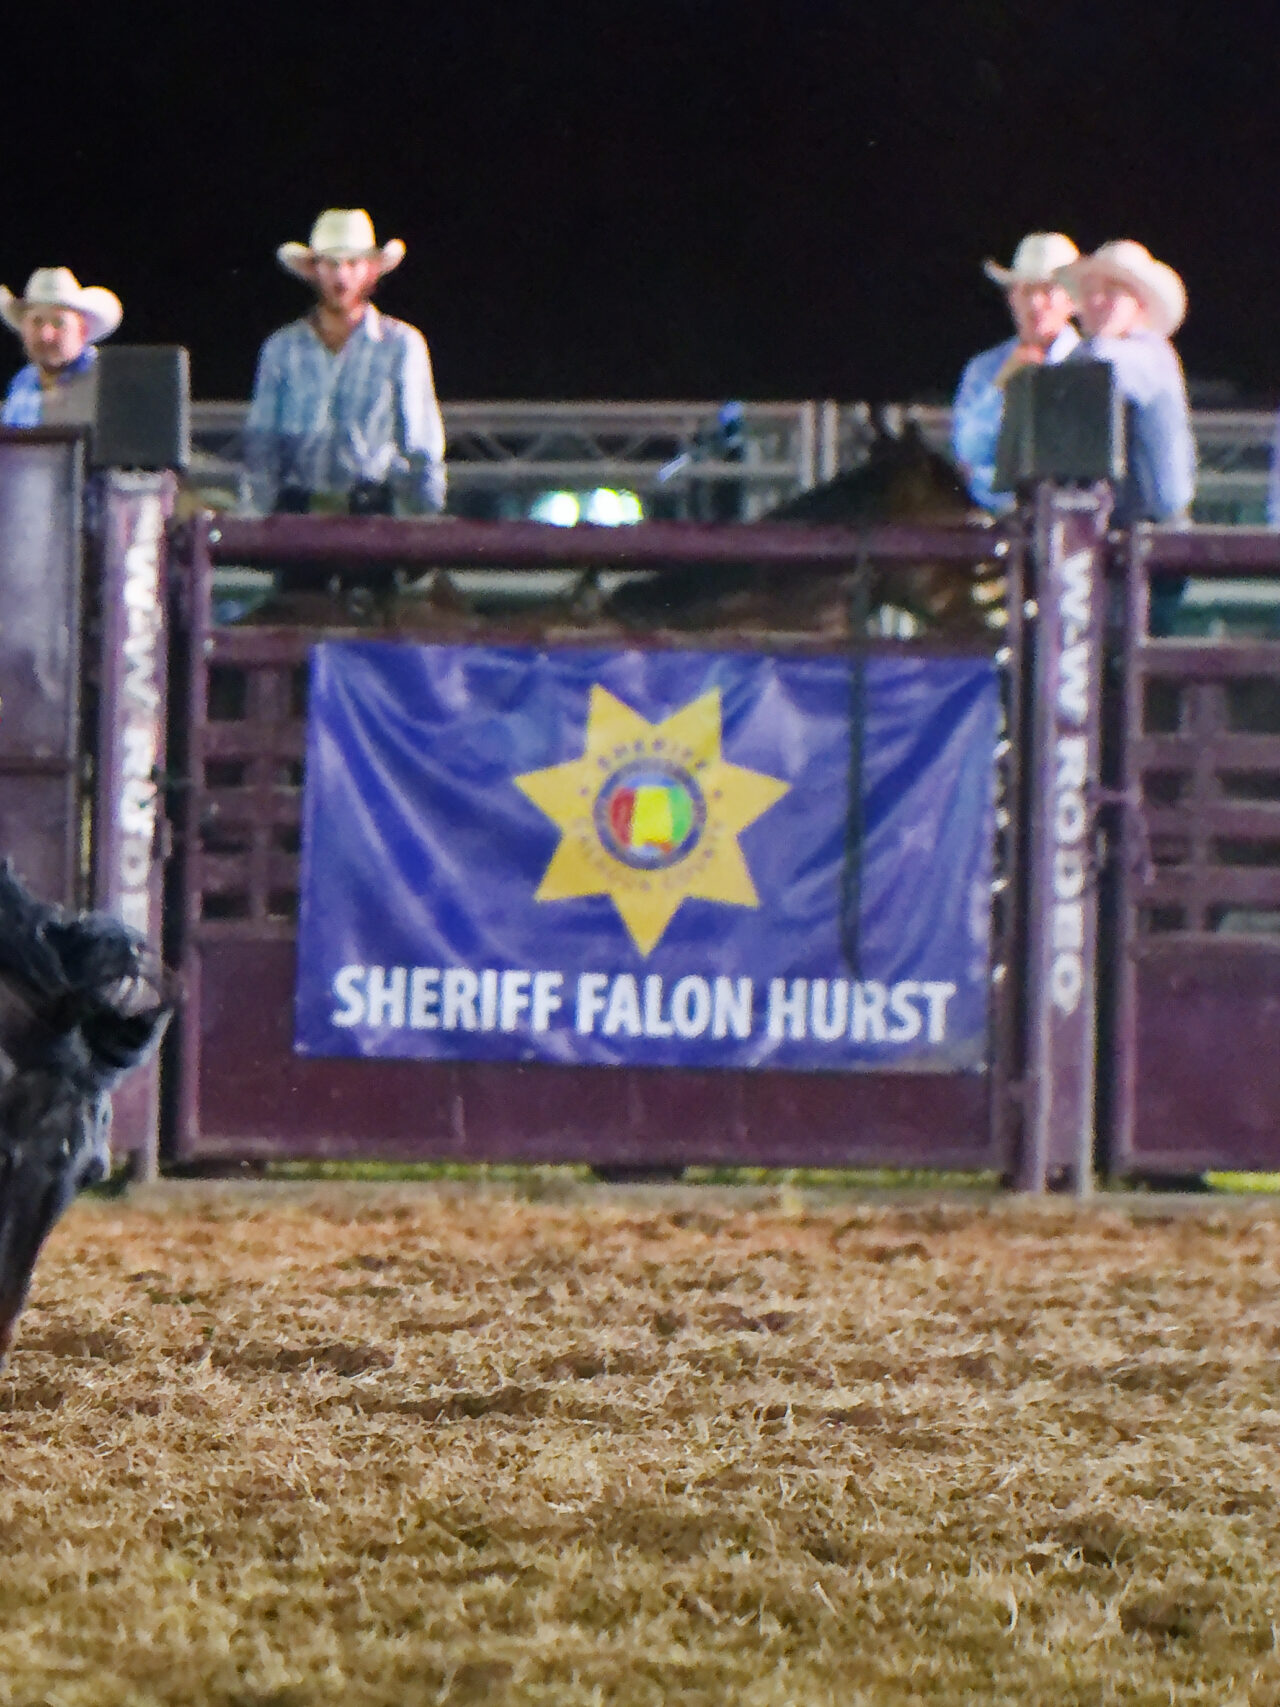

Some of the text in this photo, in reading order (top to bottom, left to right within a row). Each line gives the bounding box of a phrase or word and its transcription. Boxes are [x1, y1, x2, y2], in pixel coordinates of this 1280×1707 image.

[119, 726, 158, 936] RODE
[1051, 735, 1089, 1014] RODEO
[331, 965, 956, 1044] SHERIFF FALON HURST
